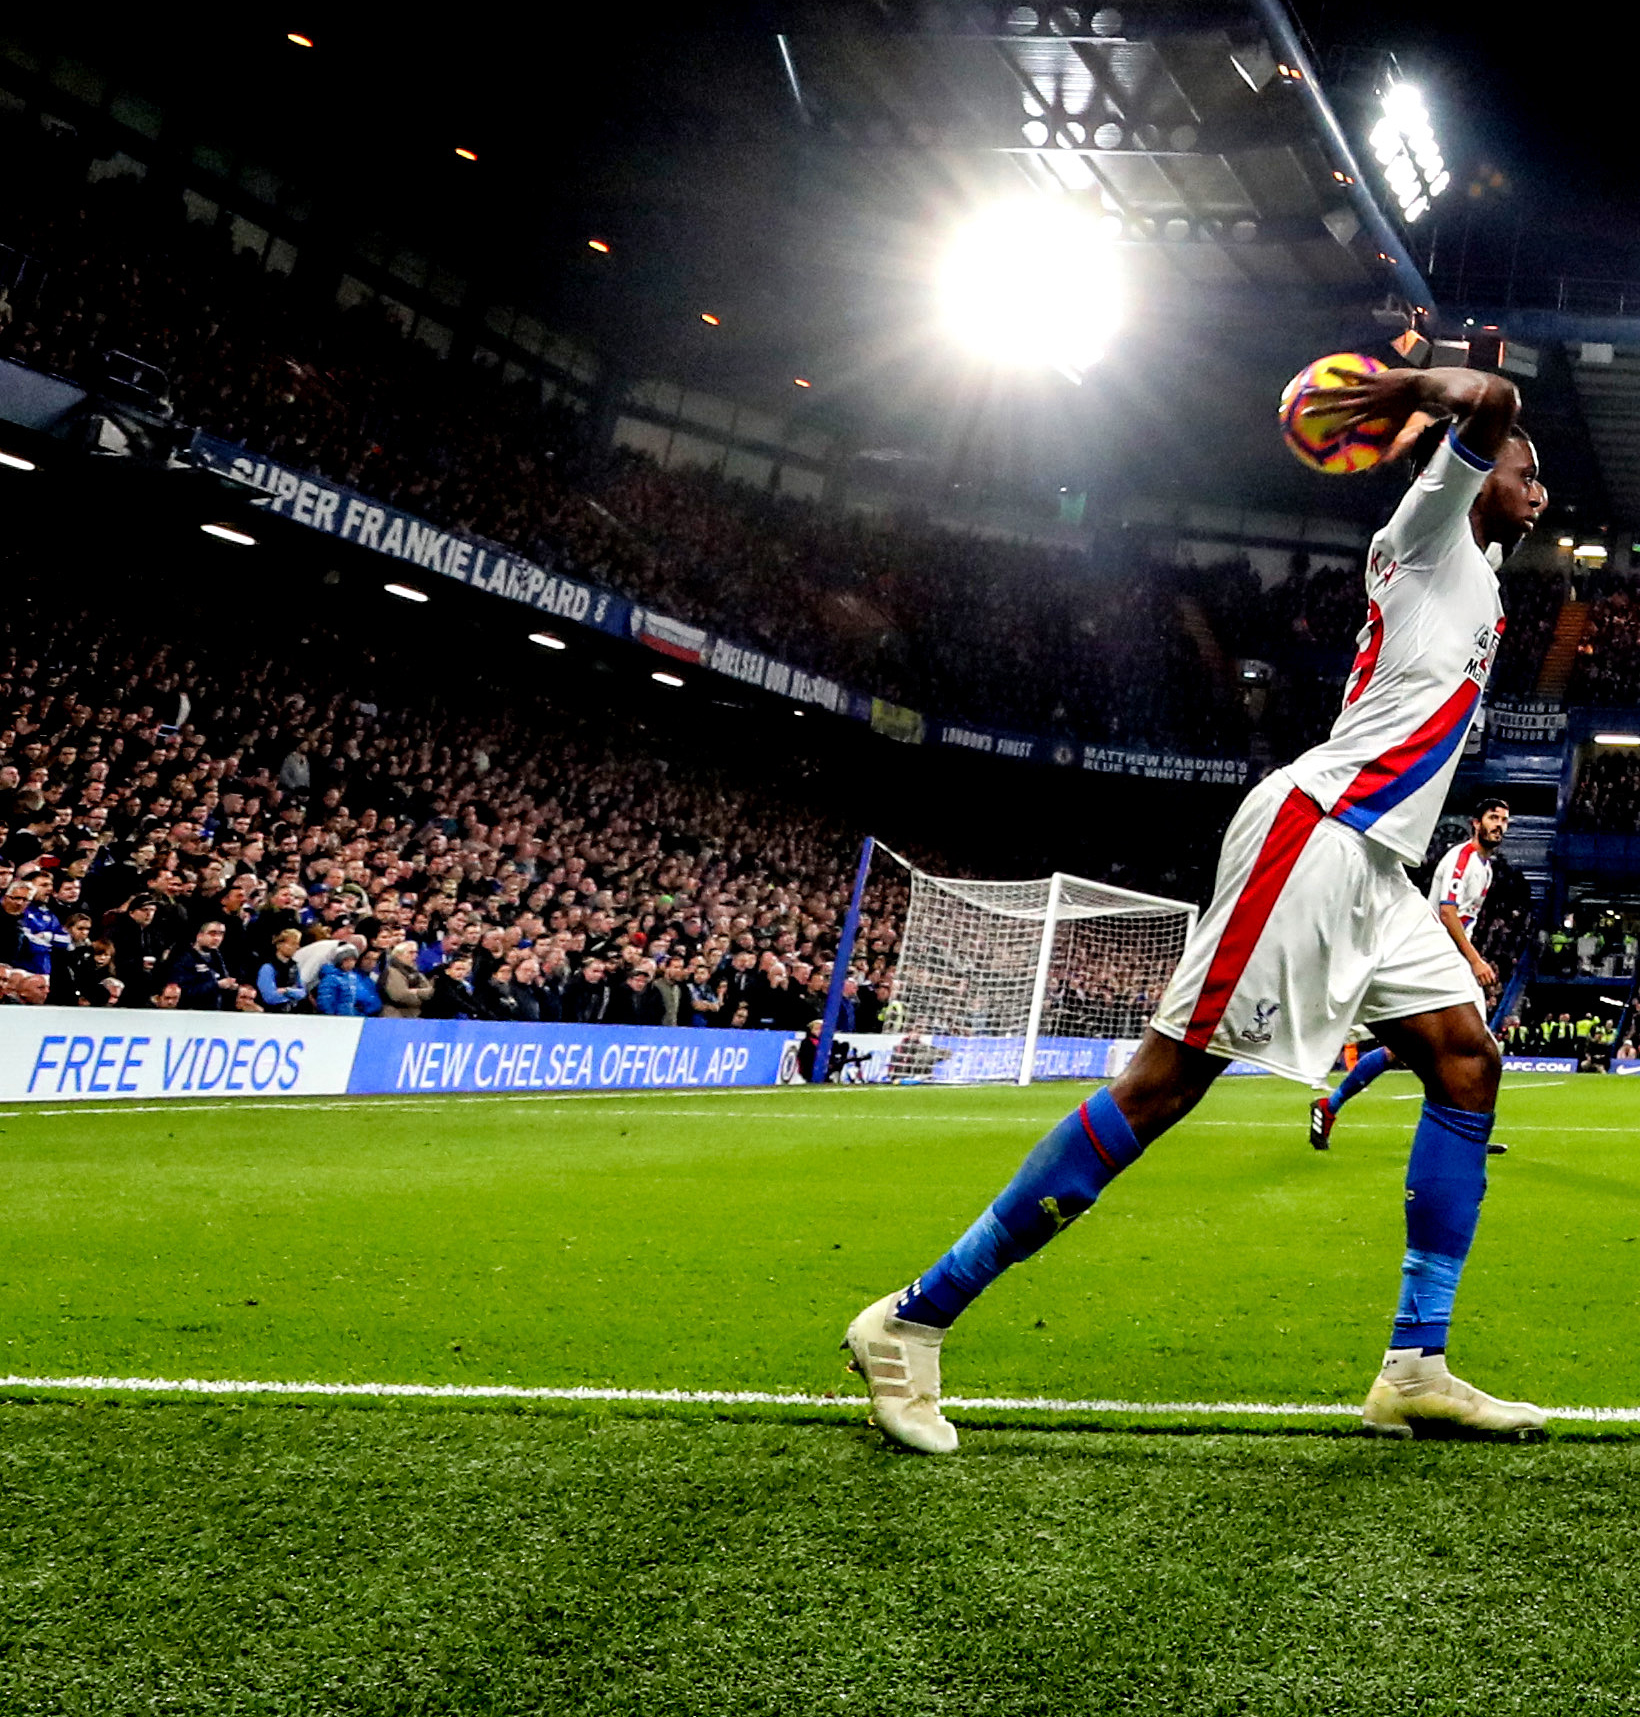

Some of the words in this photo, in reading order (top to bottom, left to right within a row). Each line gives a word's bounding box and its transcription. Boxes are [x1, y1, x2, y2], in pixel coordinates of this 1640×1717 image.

[231, 457, 340, 533] SUPER
[341, 498, 473, 580] FRANKIE
[470, 549, 591, 622] LAMPARD
[1084, 745, 1160, 767] MATTHEW
[1162, 754, 1248, 774] HARDING'S
[1143, 766, 1194, 782] WHITE
[1200, 770, 1247, 785] ARMY
[27, 1035, 151, 1093] FREE
[162, 1037, 304, 1092] VIDEOS
[396, 1041, 474, 1089] NEW
[474, 1042, 593, 1088] CHELSEA
[600, 1044, 699, 1085] OFFICIAL
[703, 1046, 750, 1084] APP
